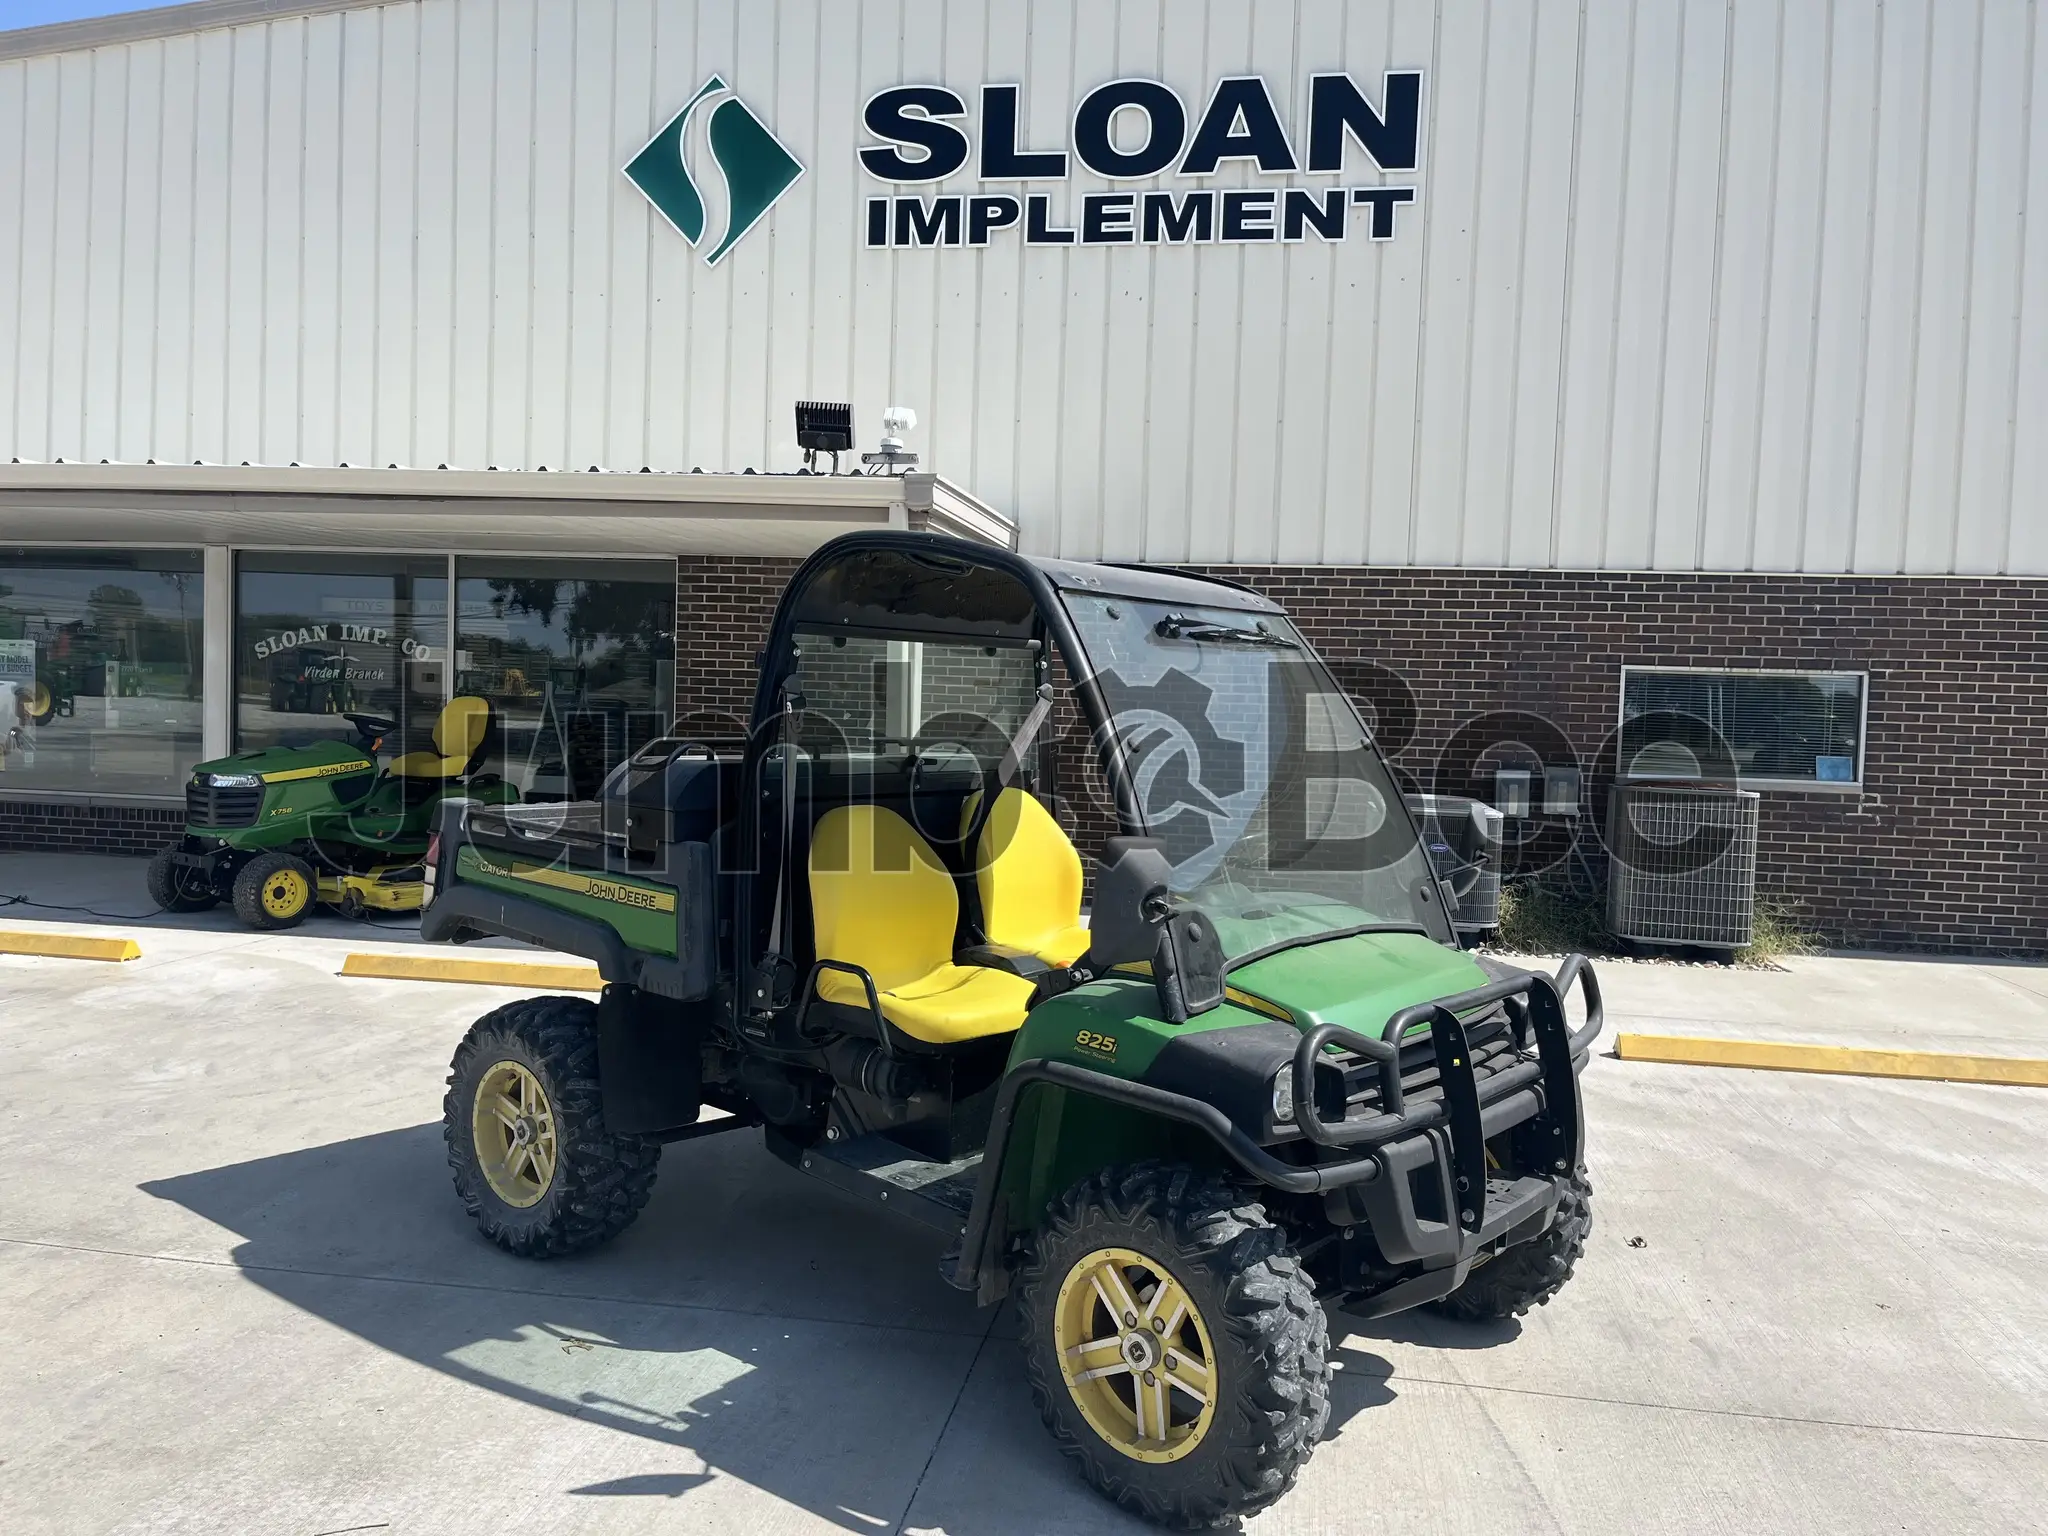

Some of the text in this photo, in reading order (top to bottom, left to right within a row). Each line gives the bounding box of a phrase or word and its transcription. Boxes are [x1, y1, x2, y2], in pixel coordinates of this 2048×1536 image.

[856, 69, 1424, 183] SLOAN
[864, 184, 1417, 250] IMPLEMENT
[344, 599, 386, 612] TOYS
[254, 624, 329, 660] SLOAN
[339, 623, 393, 648] IMP.
[304, 665, 385, 681] Virden Branch
[317, 762, 364, 777] JOHN DEERE
[479, 862, 509, 877] GATOR
[584, 878, 657, 908] JOHN DEERE
